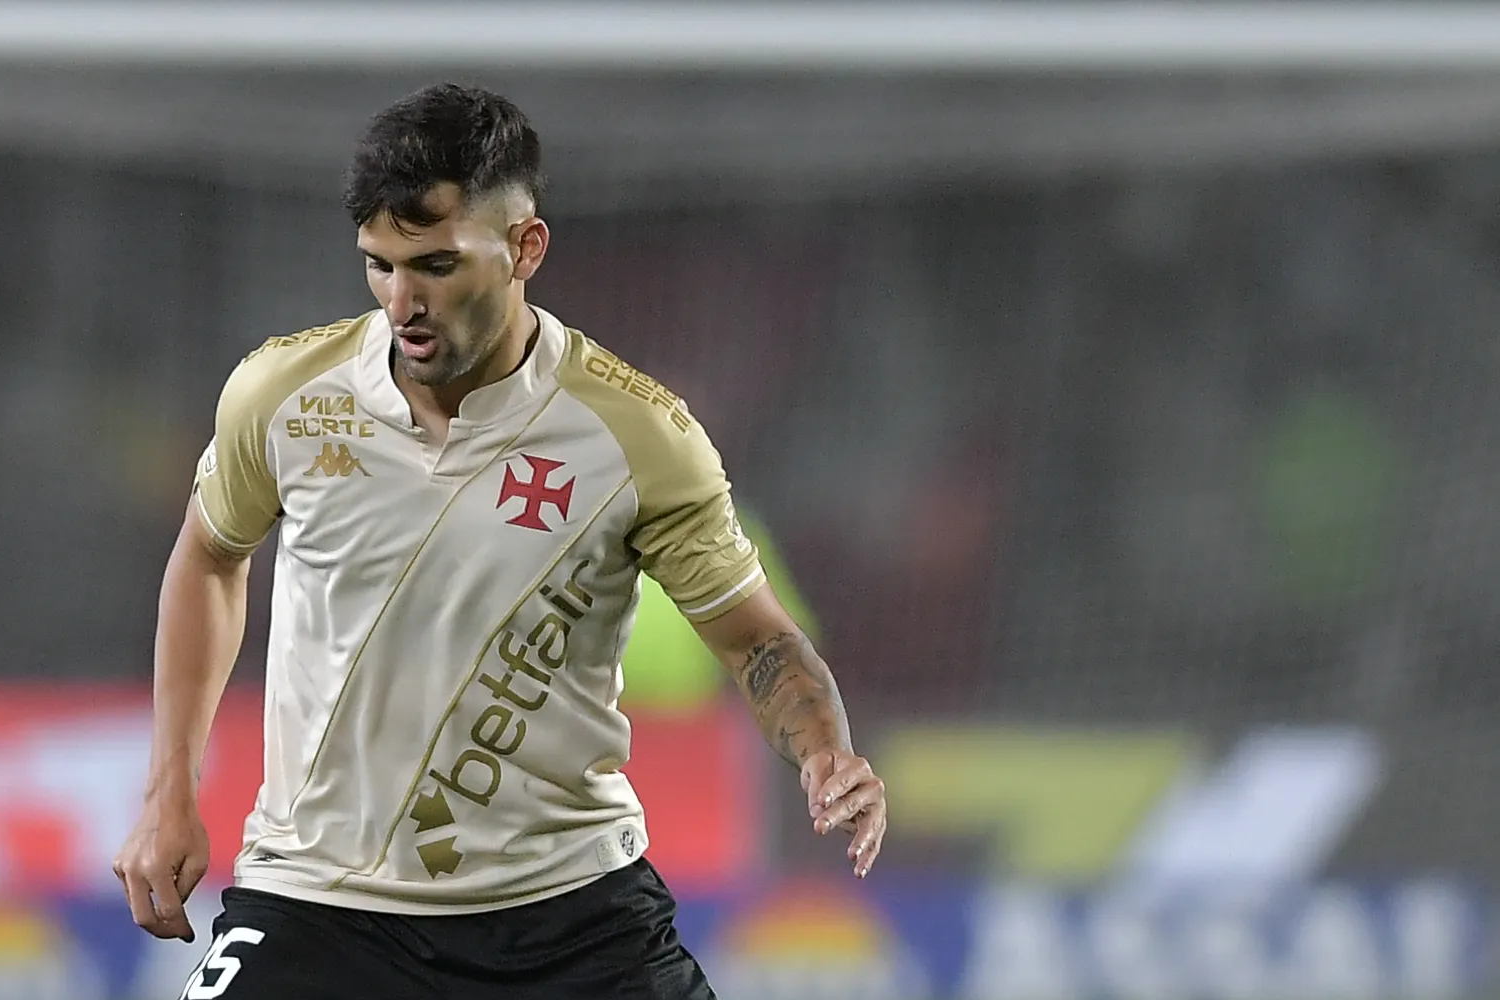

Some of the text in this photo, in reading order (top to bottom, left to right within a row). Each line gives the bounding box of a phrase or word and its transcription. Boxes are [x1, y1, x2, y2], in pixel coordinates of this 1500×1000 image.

[300, 395, 355, 415] VIVA
[585, 356, 691, 434] CHEFE
[429, 559, 593, 807] betfair
